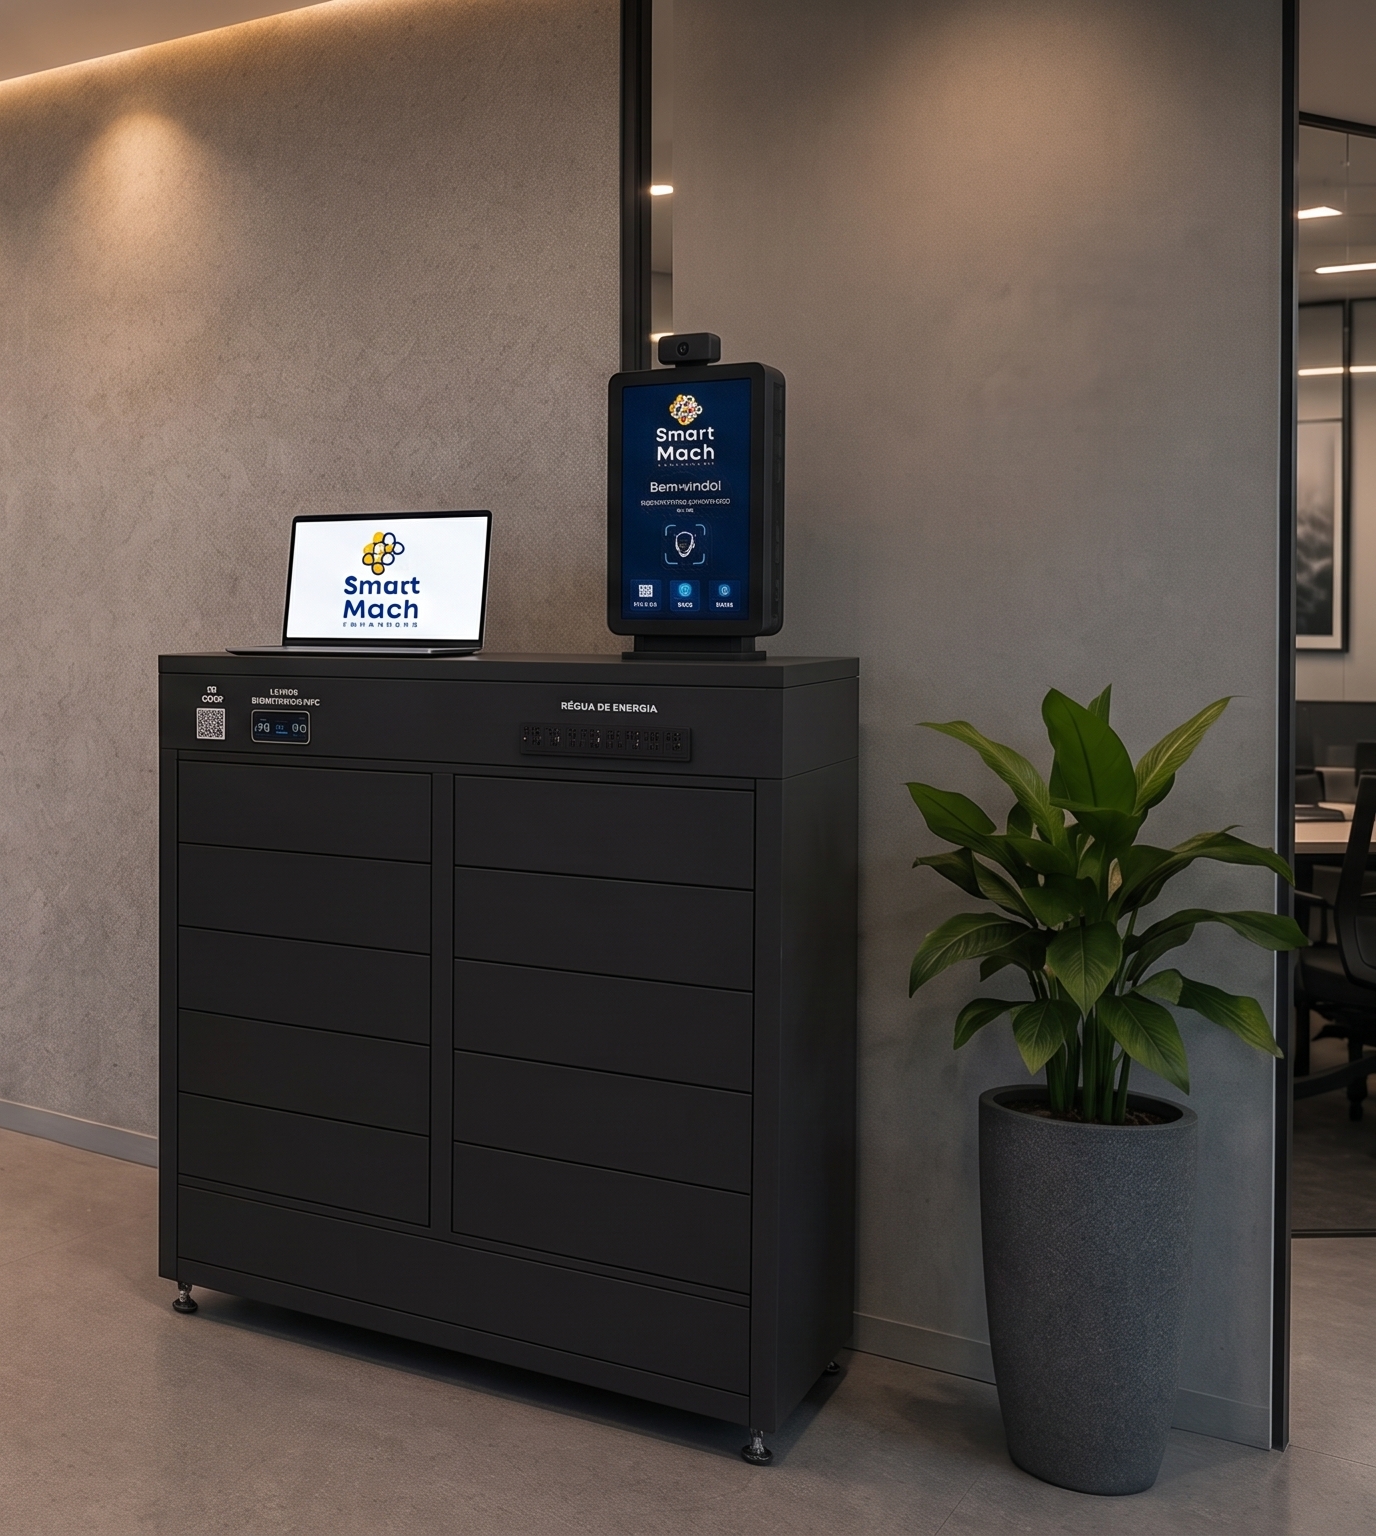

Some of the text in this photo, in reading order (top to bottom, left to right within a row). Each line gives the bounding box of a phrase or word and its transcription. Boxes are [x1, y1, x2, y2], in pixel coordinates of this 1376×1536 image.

[655, 426, 715, 442] Smart
[657, 443, 715, 461] Mach
[343, 575, 421, 595] Smart
[343, 599, 419, 619] Mach
[561, 700, 658, 714] RÉGUA DE ENERGIA
